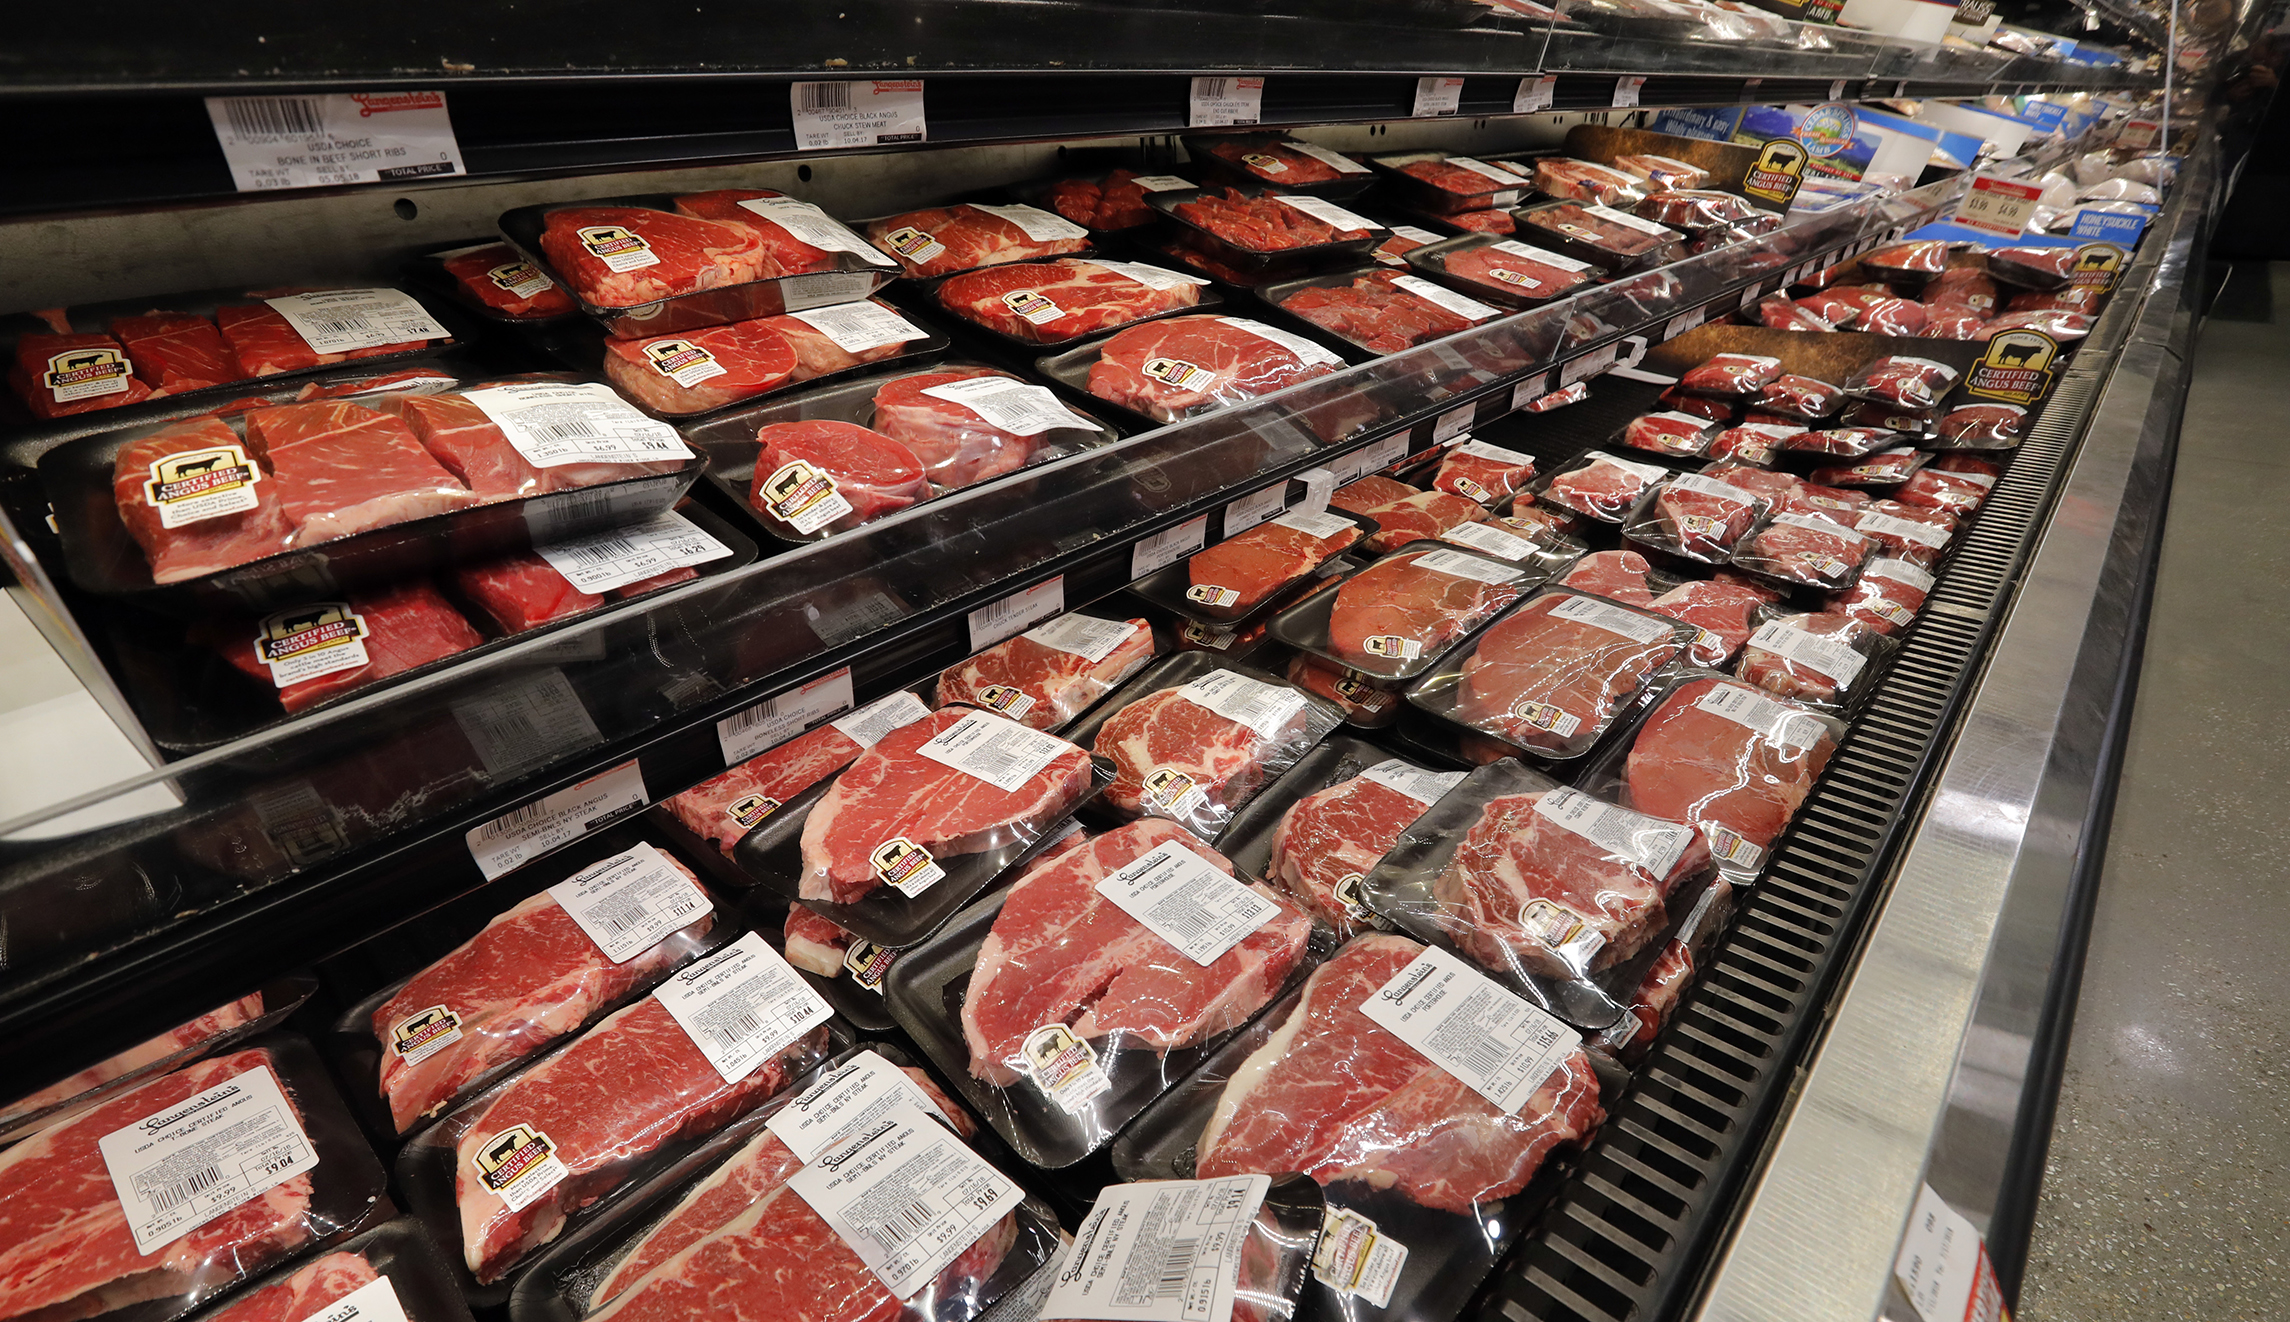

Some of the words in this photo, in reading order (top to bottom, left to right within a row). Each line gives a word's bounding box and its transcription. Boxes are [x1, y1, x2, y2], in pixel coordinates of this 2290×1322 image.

[833, 122, 854, 130] CHUCK
[855, 121, 870, 129] STEW
[872, 120, 887, 128] MEAT
[836, 113, 858, 121] CHOICE
[860, 112, 878, 120] BLACK
[879, 111, 898, 119] ANGUS
[1706, 115, 1713, 126] &
[1713, 118, 1730, 134] easy
[1805, 108, 1831, 131] CEDAR
[1832, 108, 1852, 142] SPRINGS
[1665, 120, 1684, 137] Wildly
[307, 142, 334, 152] USDA
[335, 138, 372, 150] CHOICE
[1804, 140, 1831, 155] LAMB
[277, 155, 307, 166] BONE
[310, 154, 320, 165] IN
[322, 152, 347, 164] BEEF
[350, 150, 383, 162] SHORT
[385, 147, 407, 157] RIBS
[1747, 177, 1773, 191] ANGUS
[1752, 170, 1793, 184] CERTIFIED
[1968, 199, 1989, 212] $3.99
[1998, 204, 2019, 218] $4.99
[2080, 213, 2141, 230] HONEYSUCKLE
[2076, 225, 2103, 238] WHITE
[595, 237, 632, 250] CERTIFIED
[596, 245, 622, 255] ANGUS
[661, 349, 697, 367] CERTIFIED
[664, 358, 689, 372] ANGUS
[53, 373, 92, 385] ANGUS
[56, 363, 115, 380] CERTIFIED
[1978, 367, 2040, 381] CERTIFIED
[1969, 375, 2009, 389] ANGUS
[161, 467, 238, 493] CERTIFIED
[157, 482, 210, 501] ANGUS
[679, 544, 706, 556] $6.29
[635, 557, 657, 568] $6.99
[581, 574, 602, 584] 0.900
[993, 618, 1008, 629] CHUCK
[1008, 609, 1025, 621] TENDER
[1025, 602, 1039, 612] STEAK
[270, 621, 345, 650] CERTIFIED
[267, 637, 318, 658] ANGUS
[279, 667, 306, 678] brand's
[308, 662, 323, 671] high
[324, 653, 359, 667] standards
[290, 661, 312, 670] cattle
[313, 656, 332, 664] meet
[334, 651, 346, 659] the
[754, 724, 786, 741] BONELESS
[786, 715, 805, 730] SHORT
[806, 708, 820, 719] RIBS
[766, 716, 782, 728] USDA
[783, 707, 806, 721] CHOICE
[505, 826, 527, 840] USDA
[528, 815, 557, 830] CHOICE
[558, 804, 583, 820] BLACK
[583, 792, 608, 807] ANGUS
[741, 802, 768, 822] CERTIFIED
[522, 821, 562, 842] SEMI-BNLS
[563, 814, 575, 824] NY
[575, 805, 598, 820] STEAK
[538, 831, 555, 842] SELL
[541, 830, 572, 848] 10.04.17
[491, 850, 509, 863] TARE
[497, 856, 514, 869] 0.02
[887, 851, 917, 877] CERTIFIED
[890, 865, 911, 882] ANGUS
[673, 901, 695, 917] $11.14
[1241, 904, 1262, 919] $13.13
[647, 920, 662, 932] $9.99
[1219, 923, 1236, 937] $10.99
[862, 948, 892, 980] CERTIFIED
[866, 963, 887, 985] ANGUS
[1421, 989, 1447, 1012] PORTERHOUSE
[789, 1006, 814, 1024] $10.44
[400, 1031, 432, 1053] ANGUS
[401, 1018, 447, 1047] CERTIFIED
[762, 1029, 779, 1043] $9.99
[1536, 1029, 1559, 1049] $15.66
[725, 1057, 740, 1070] 1.045
[1041, 1046, 1078, 1079] CERTIFIED
[1516, 1056, 1535, 1073] $10.99
[1044, 1063, 1071, 1087] ANGUS
[138, 1085, 242, 1136] Langenstein's
[798, 1118, 814, 1130] USDA
[813, 1103, 833, 1119] CHOICE
[832, 1081, 860, 1103] CERTIFIED
[816, 1101, 845, 1125] SEMI-BNLS
[853, 1082, 869, 1097] STEAK
[134, 1141, 155, 1154] USDA
[157, 1126, 186, 1143] CHOICE
[188, 1106, 229, 1128] CERTIFIED
[171, 1125, 199, 1142] T-BONE
[201, 1112, 225, 1127] STEAK
[818, 1120, 898, 1172] Langenstein's
[264, 1155, 295, 1175] $9.04
[490, 1141, 536, 1181] CERTIFIED
[826, 1178, 842, 1191] USDA
[843, 1161, 864, 1179] CHOICE
[865, 1139, 897, 1162] CERTIFIED
[897, 1128, 915, 1141] ANGUS
[846, 1160, 878, 1184] SEMI-BNLS
[887, 1141, 906, 1155] STEAK
[493, 1161, 524, 1189] ANGUS
[510, 1179, 525, 1191] More
[525, 1163, 548, 1180] selective
[211, 1186, 237, 1203] $9.99
[510, 1187, 521, 1197] than
[521, 1177, 537, 1189] USDA
[961, 1176, 986, 1196] 07/16/18
[962, 1192, 976, 1207] Total
[976, 1183, 991, 1195] Price
[973, 1187, 999, 1211] $9.69
[148, 1218, 173, 1237] 0.905
[936, 1223, 957, 1244] $9.99
[1060, 1206, 1111, 1288] Langenstein's
[1090, 1254, 1104, 1277] CHOICE
[1101, 1218, 1121, 1251] CERTIFIED
[1211, 1231, 1226, 1252] $9.99
[892, 1262, 913, 1281] 0.970
[1197, 1286, 1210, 1313] 0.915
